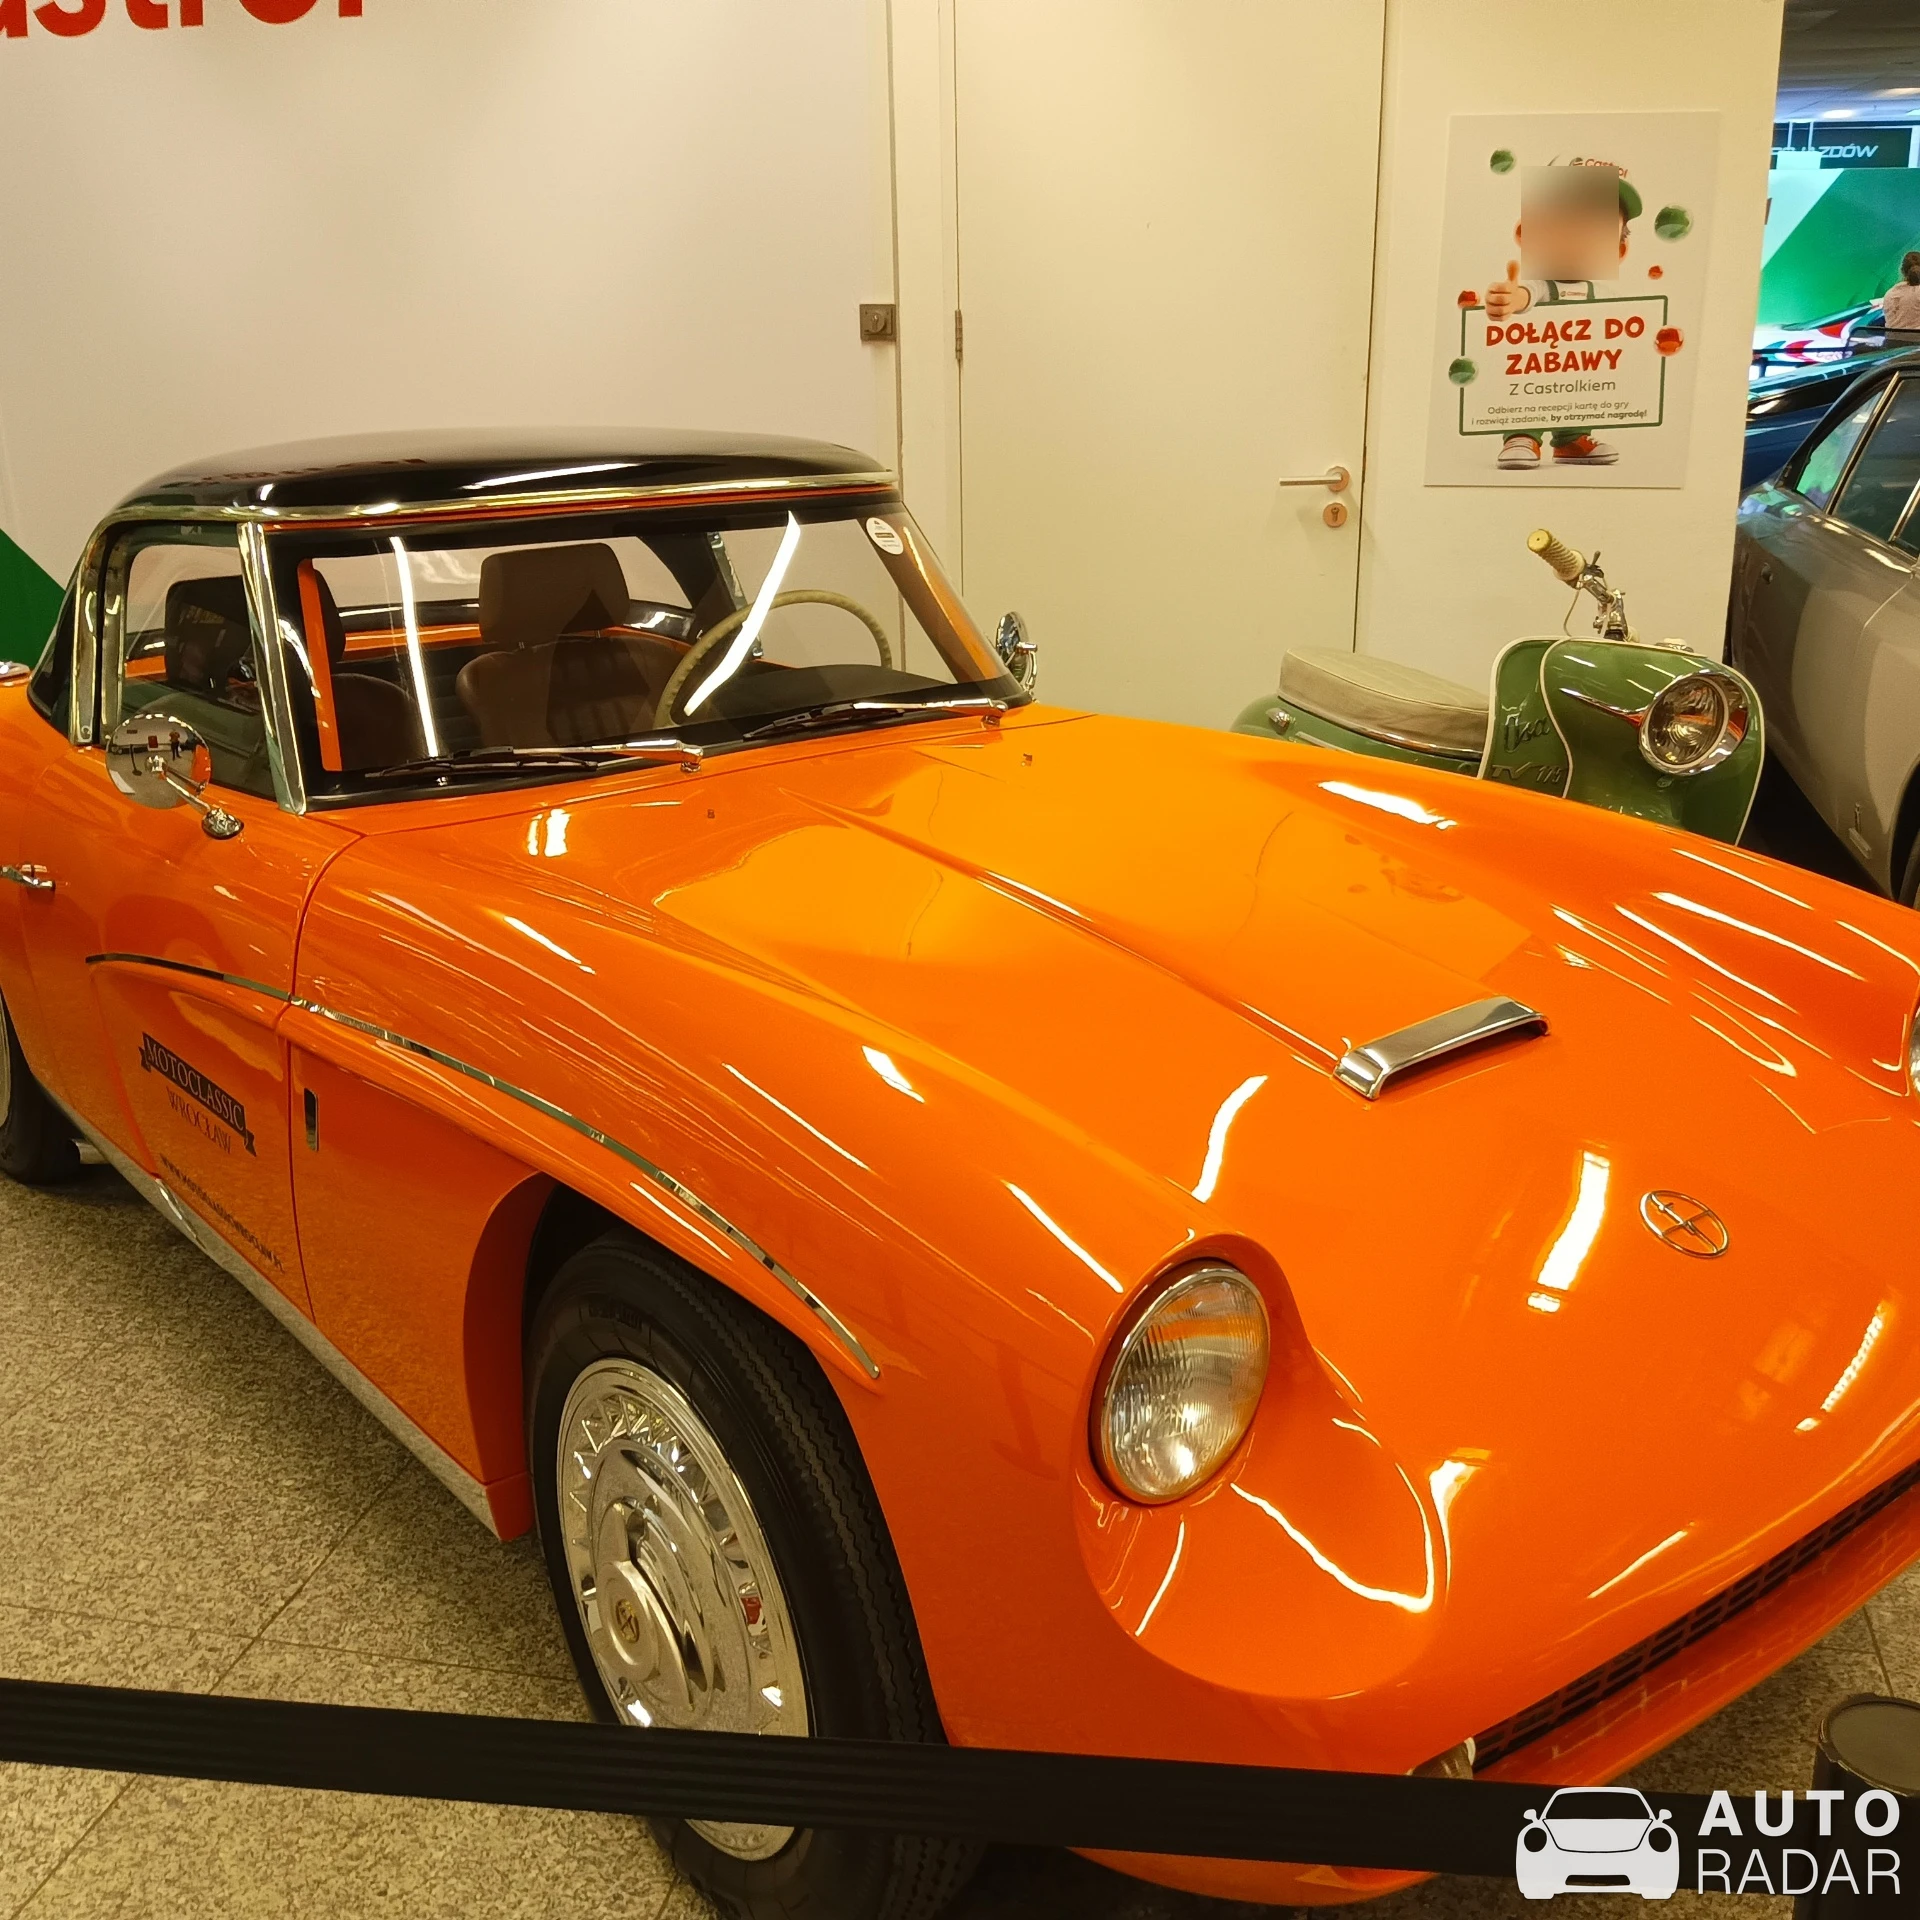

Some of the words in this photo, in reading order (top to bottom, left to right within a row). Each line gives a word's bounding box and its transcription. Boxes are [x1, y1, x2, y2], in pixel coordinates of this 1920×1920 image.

[1486, 319, 1591, 349] DOŁĄCZ
[1604, 316, 1645, 340] DO
[1505, 348, 1623, 375] ZABAWY
[1509, 384, 1519, 396] Z
[1523, 379, 1616, 396] Castrolkiem
[1487, 406, 1522, 415] Odbierz
[1538, 403, 1573, 413] recepcji
[1575, 402, 1598, 411] kartę
[1614, 401, 1629, 410] gry
[1511, 416, 1549, 424] zadanie,
[1550, 414, 1561, 422] by
[1563, 411, 1605, 421] otrzymać
[1607, 409, 1647, 419] nagrodę!
[145, 1036, 244, 1132] MOTOCLASSIC
[166, 1085, 231, 1155] WROCŁAW
